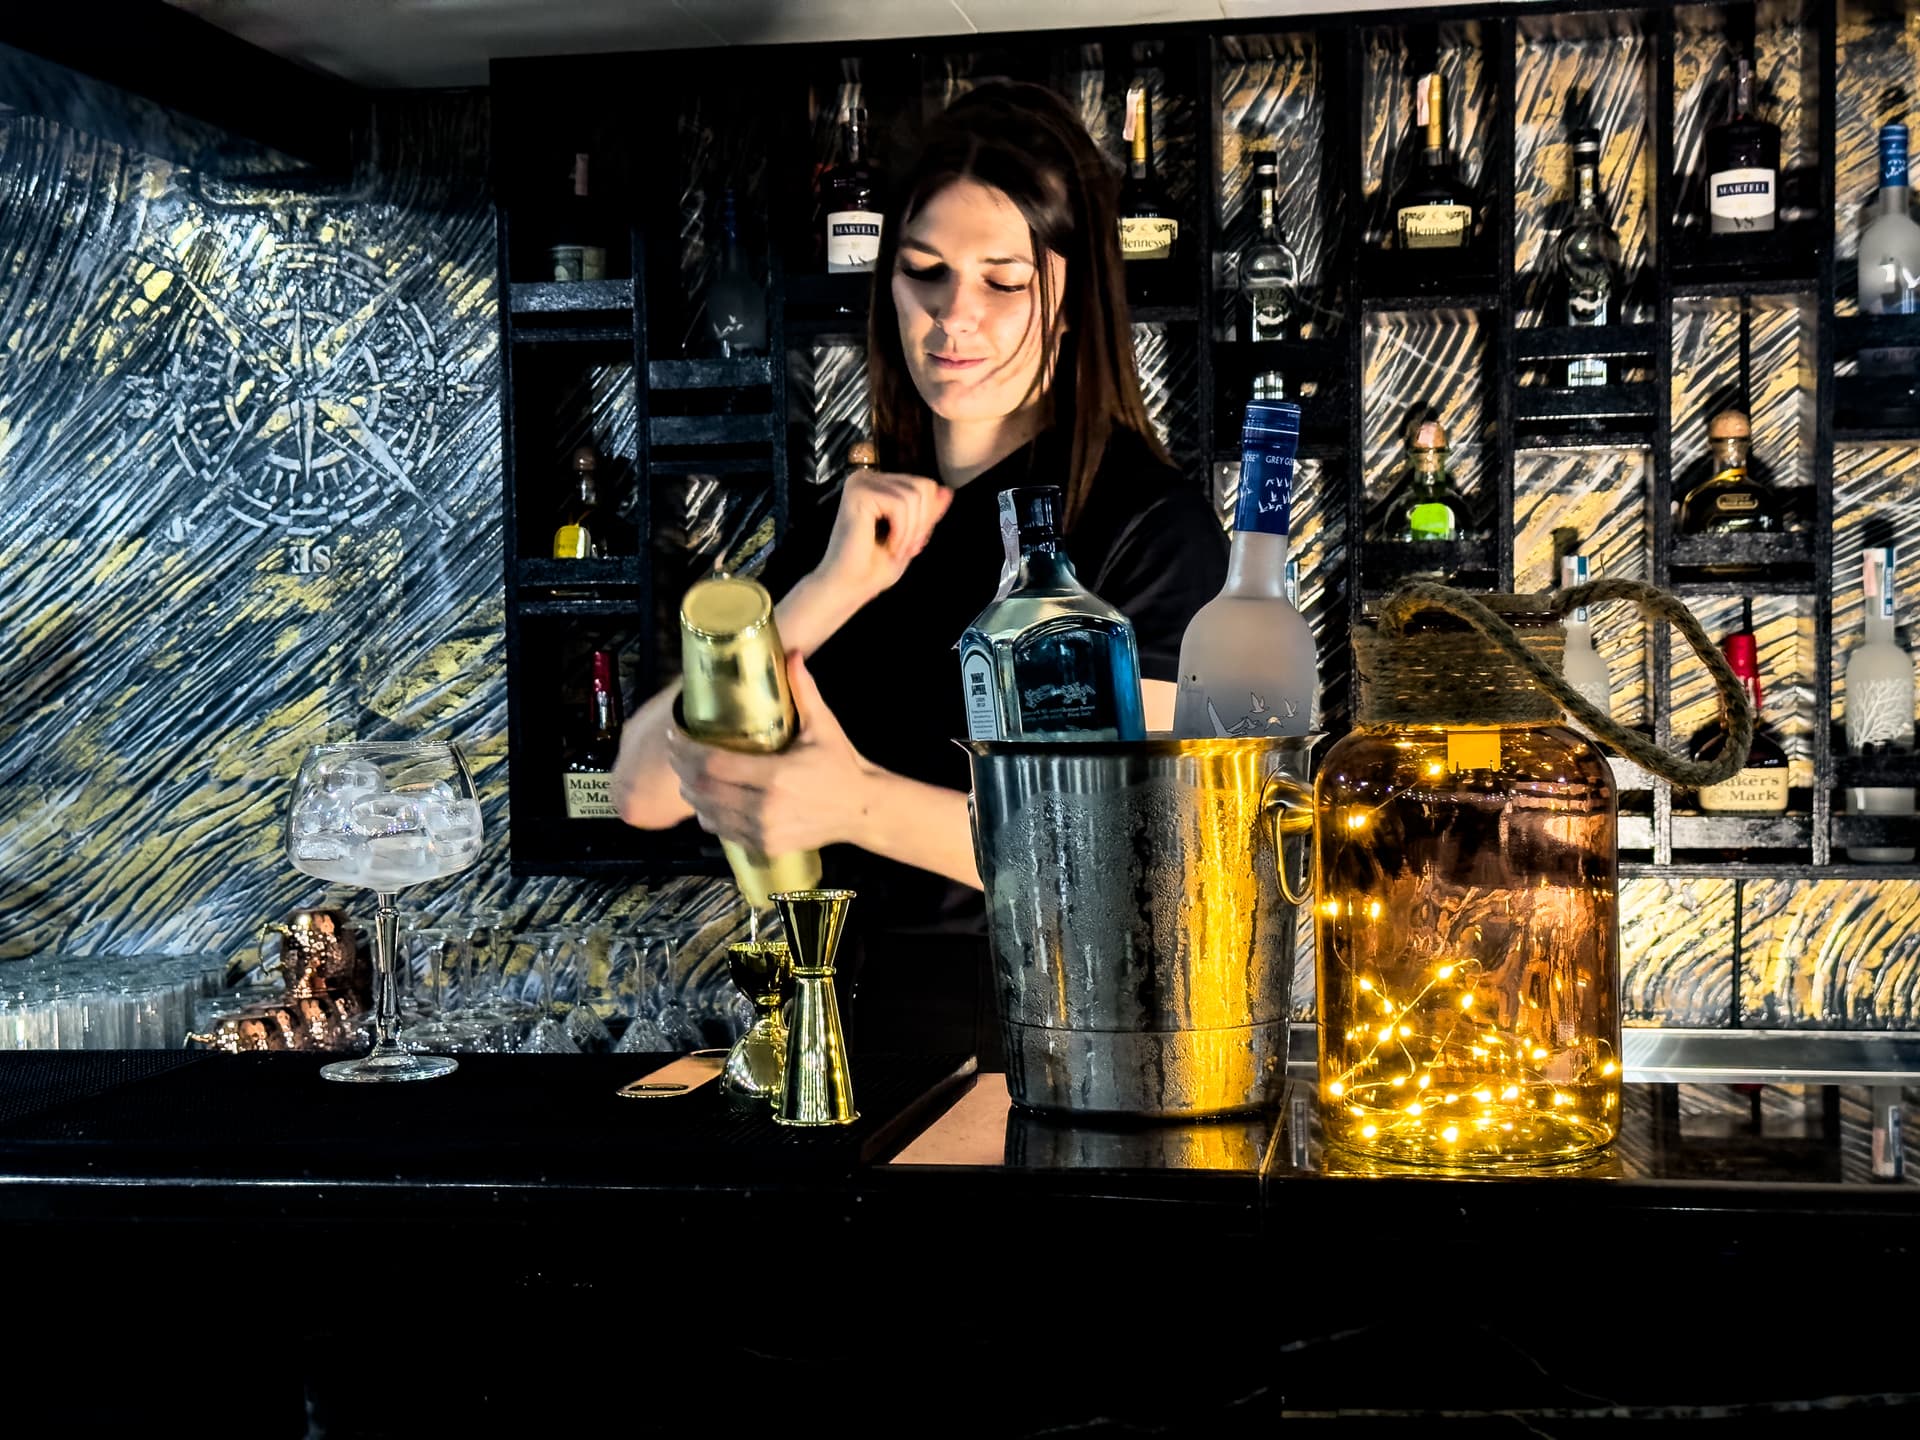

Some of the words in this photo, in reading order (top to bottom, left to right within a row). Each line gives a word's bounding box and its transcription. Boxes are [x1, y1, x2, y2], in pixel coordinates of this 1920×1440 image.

[1719, 182, 1766, 195] MARTELL
[835, 224, 877, 235] MARTELL
[1265, 455, 1285, 465] GREY
[569, 779, 612, 790] Make
[1721, 775, 1780, 787] aker's
[1729, 789, 1780, 801] Mark
